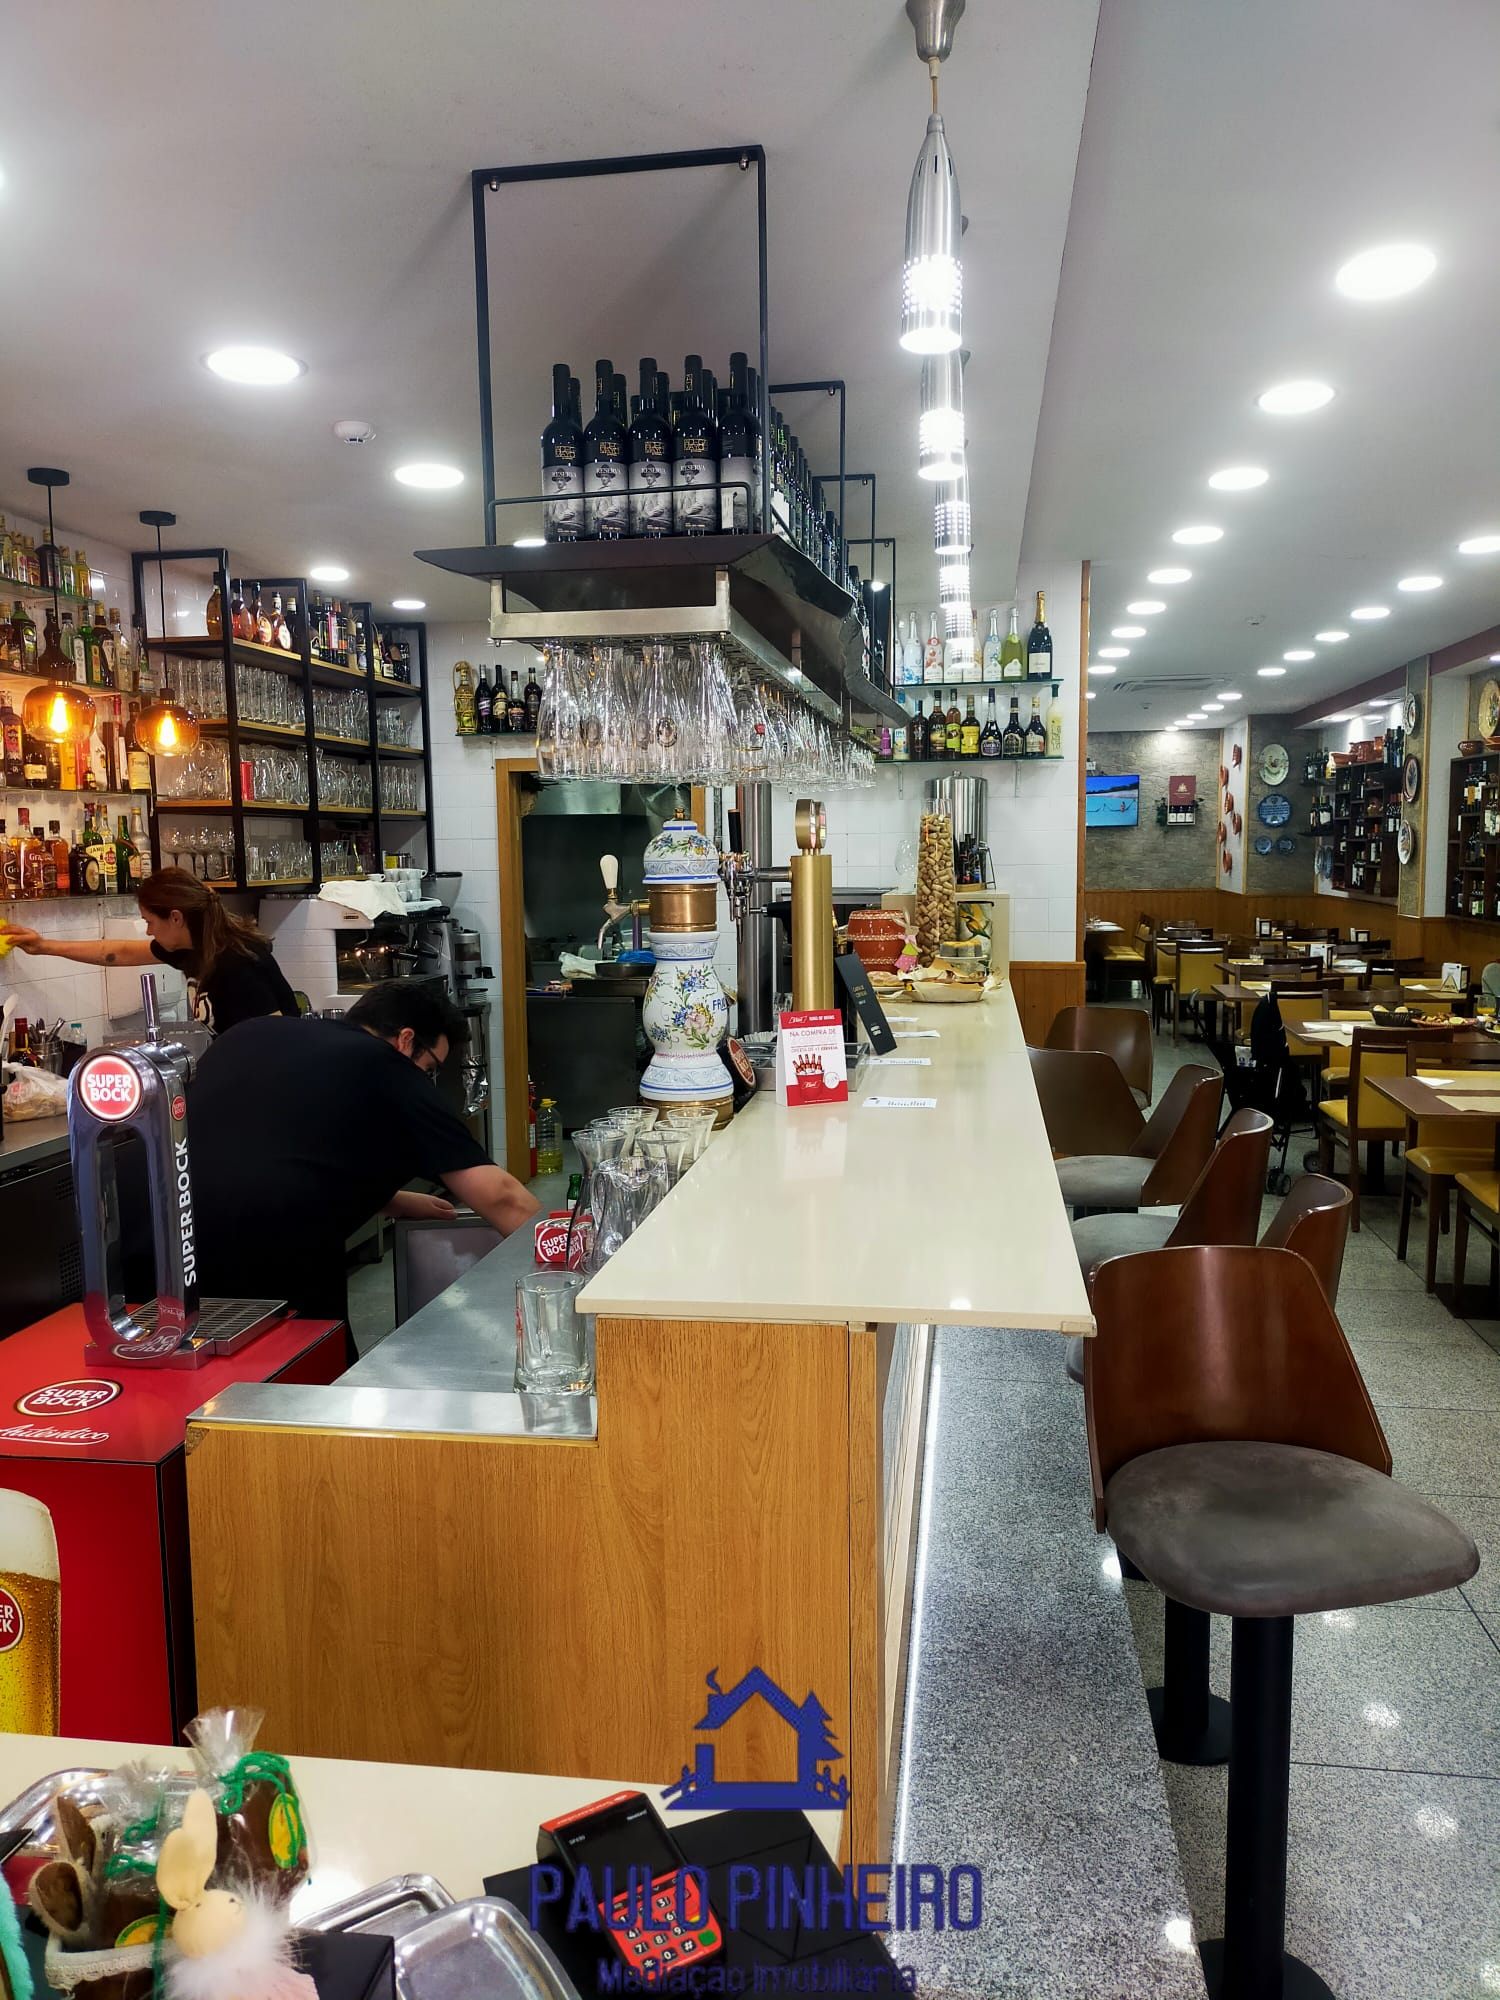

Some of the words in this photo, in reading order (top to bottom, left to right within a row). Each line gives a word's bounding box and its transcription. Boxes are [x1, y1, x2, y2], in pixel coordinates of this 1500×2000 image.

[680, 464, 706, 472] RESERVA
[801, 1029, 827, 1037] COMPRA
[87, 1073, 132, 1088] SUPER
[89, 1087, 131, 1102] BOCK
[175, 1137, 191, 1209] BOCK
[180, 1209, 197, 1287] SUPER
[40, 1388, 108, 1399] SUPER
[30, 1396, 96, 1407] BOCK
